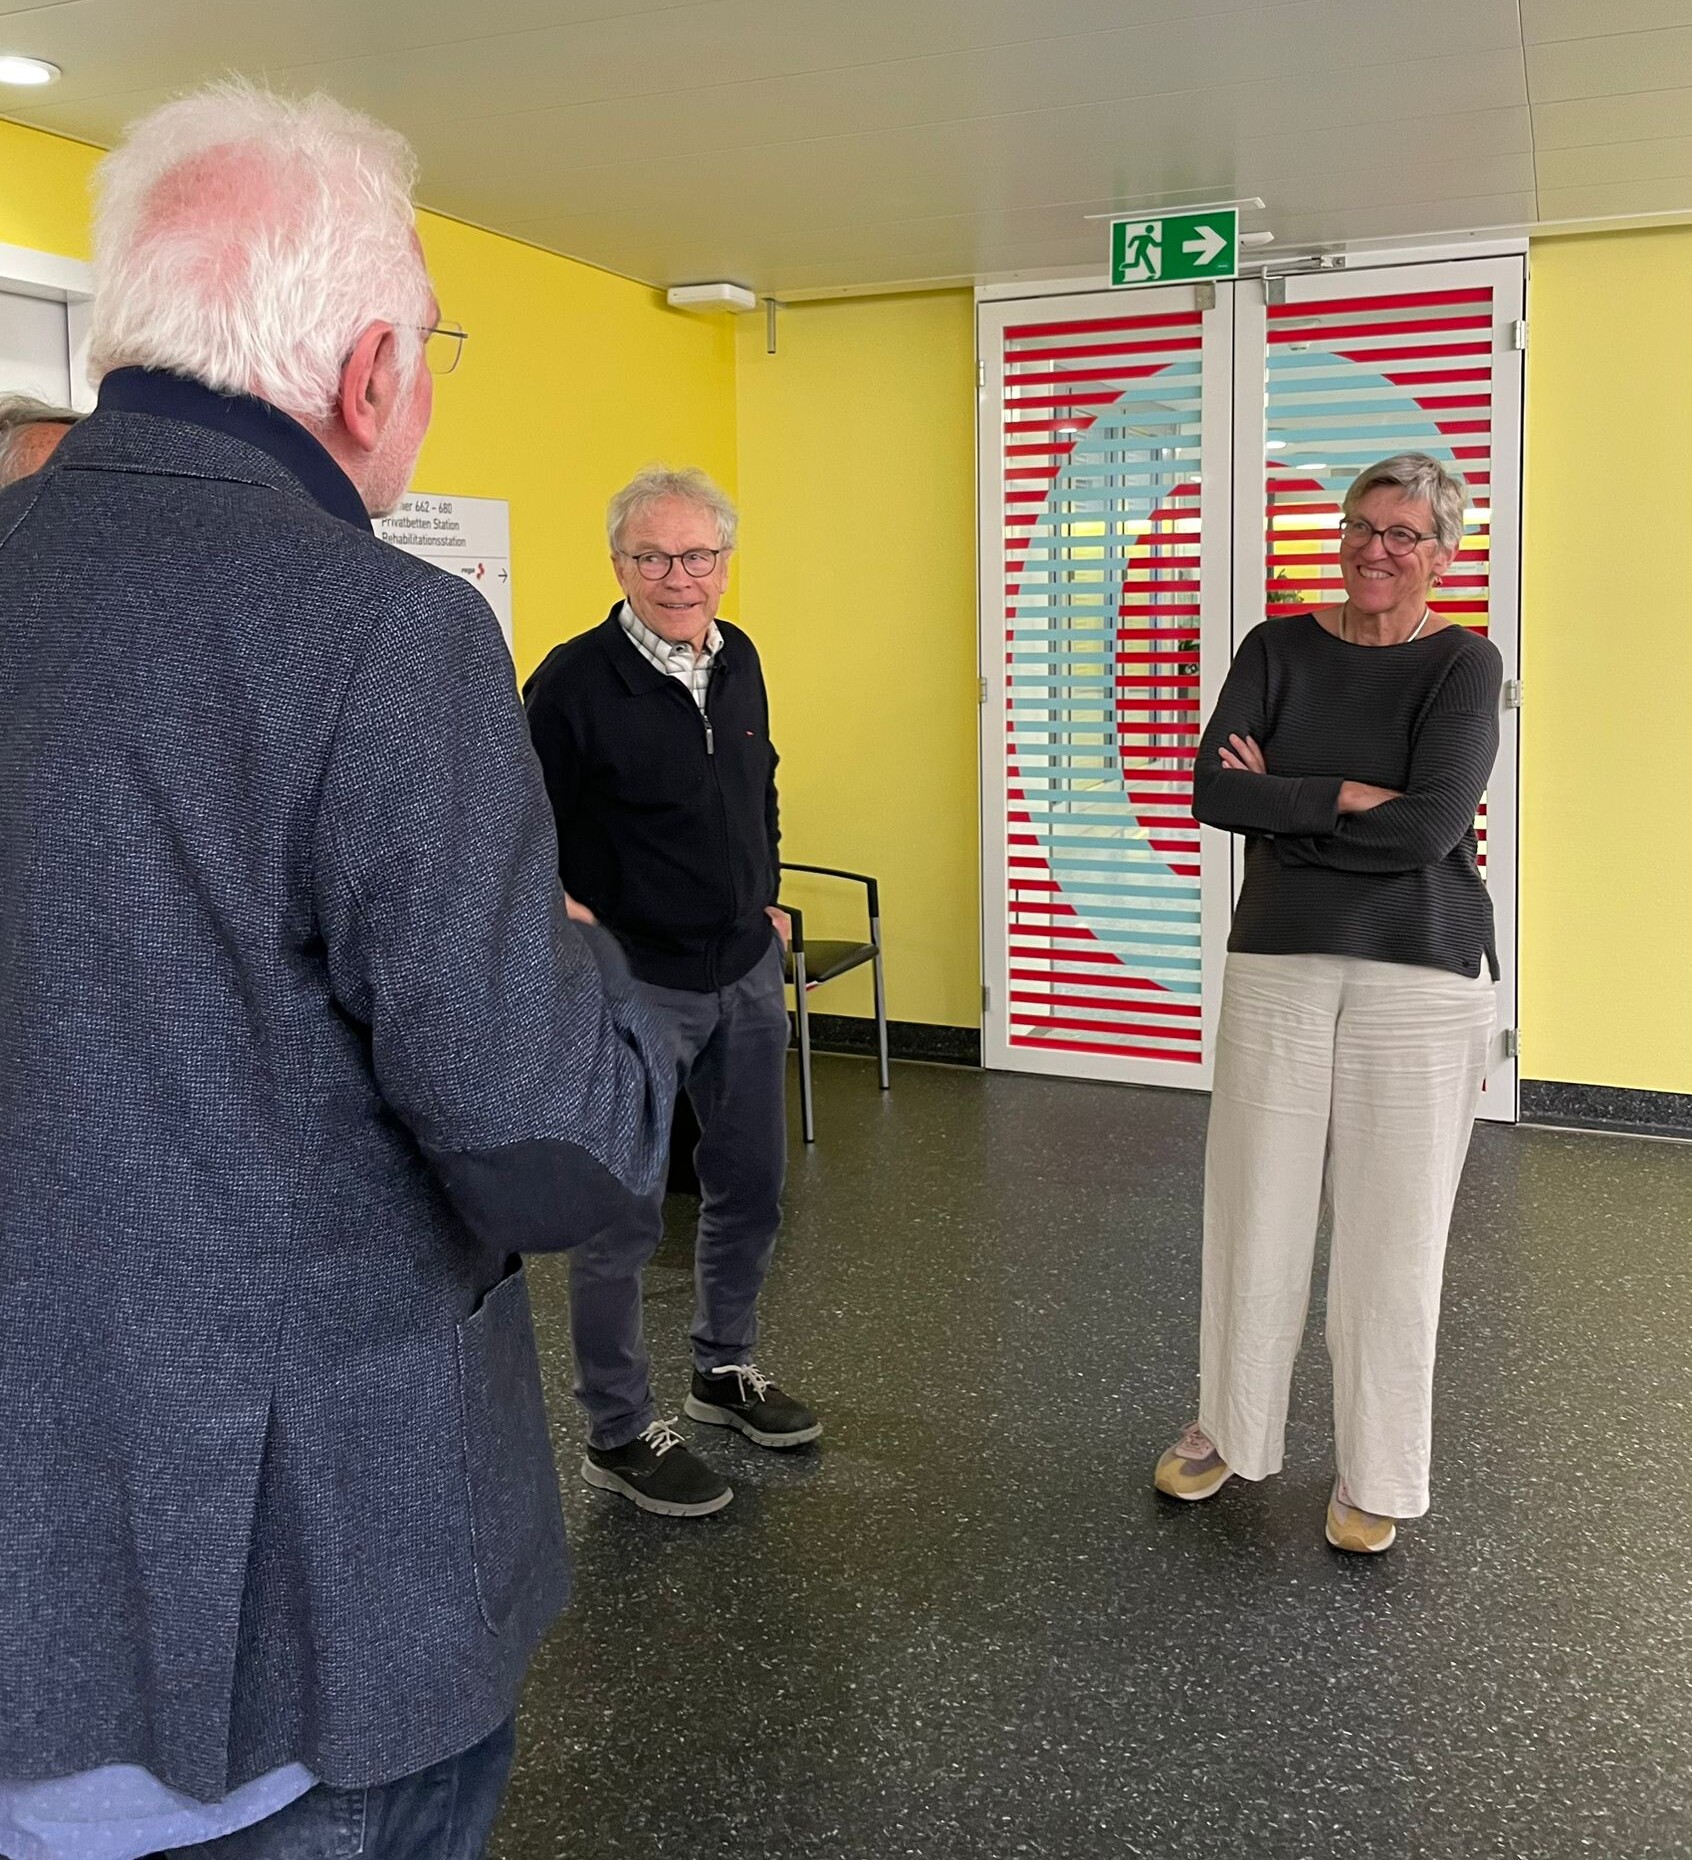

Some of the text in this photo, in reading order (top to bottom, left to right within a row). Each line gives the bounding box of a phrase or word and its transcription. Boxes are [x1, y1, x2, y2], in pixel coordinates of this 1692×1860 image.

[415, 500, 430, 513] 662
[439, 502, 452, 514] 680
[381, 516, 460, 530] Privatbetten Station
[381, 532, 467, 546] Rehabilitationsstation
